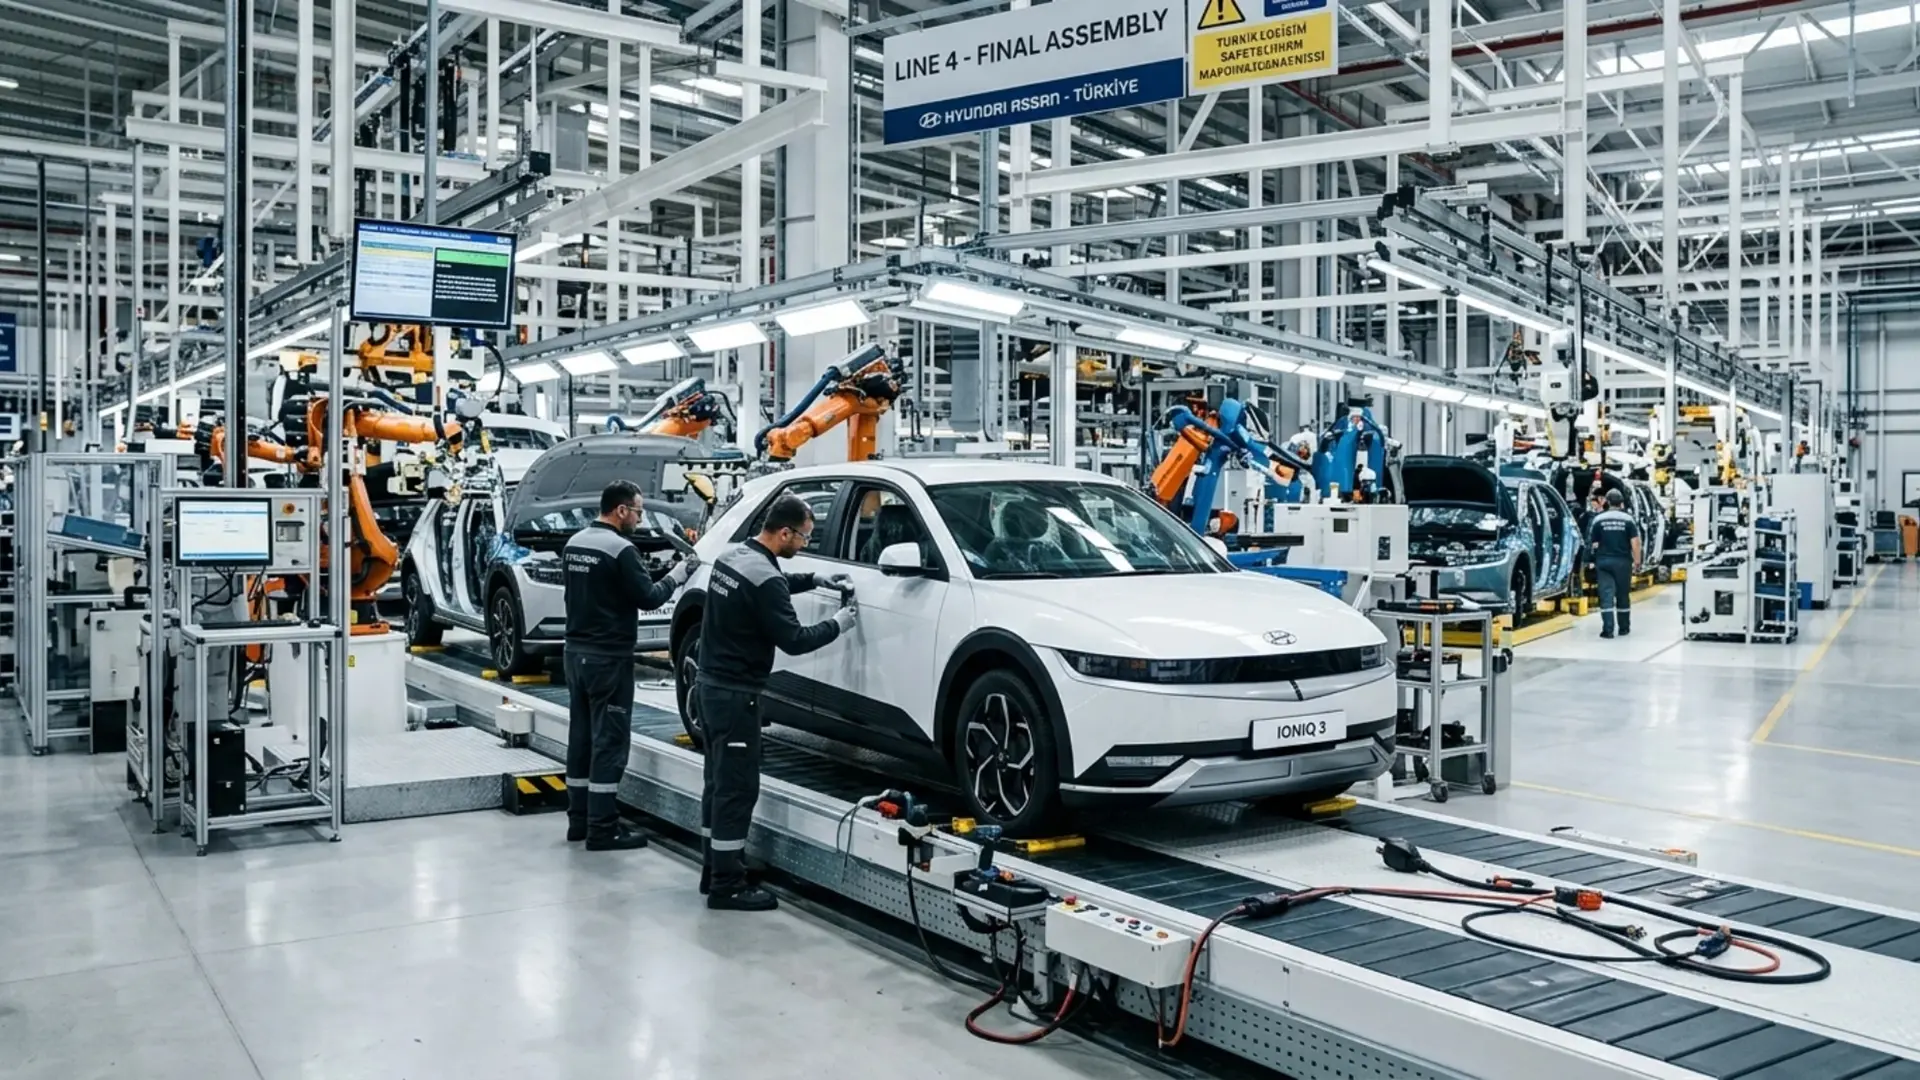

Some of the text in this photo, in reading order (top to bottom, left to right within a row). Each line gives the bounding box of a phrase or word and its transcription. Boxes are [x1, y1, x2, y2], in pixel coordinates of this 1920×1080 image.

[895, 54, 940, 81] LINE
[945, 51, 958, 71] 4
[977, 35, 1041, 65] FINAL
[1045, 8, 1168, 52] ASSEMBLY
[1073, 78, 1139, 102] TÜRKİYE
[1277, 721, 1326, 739] IONIQ 3
